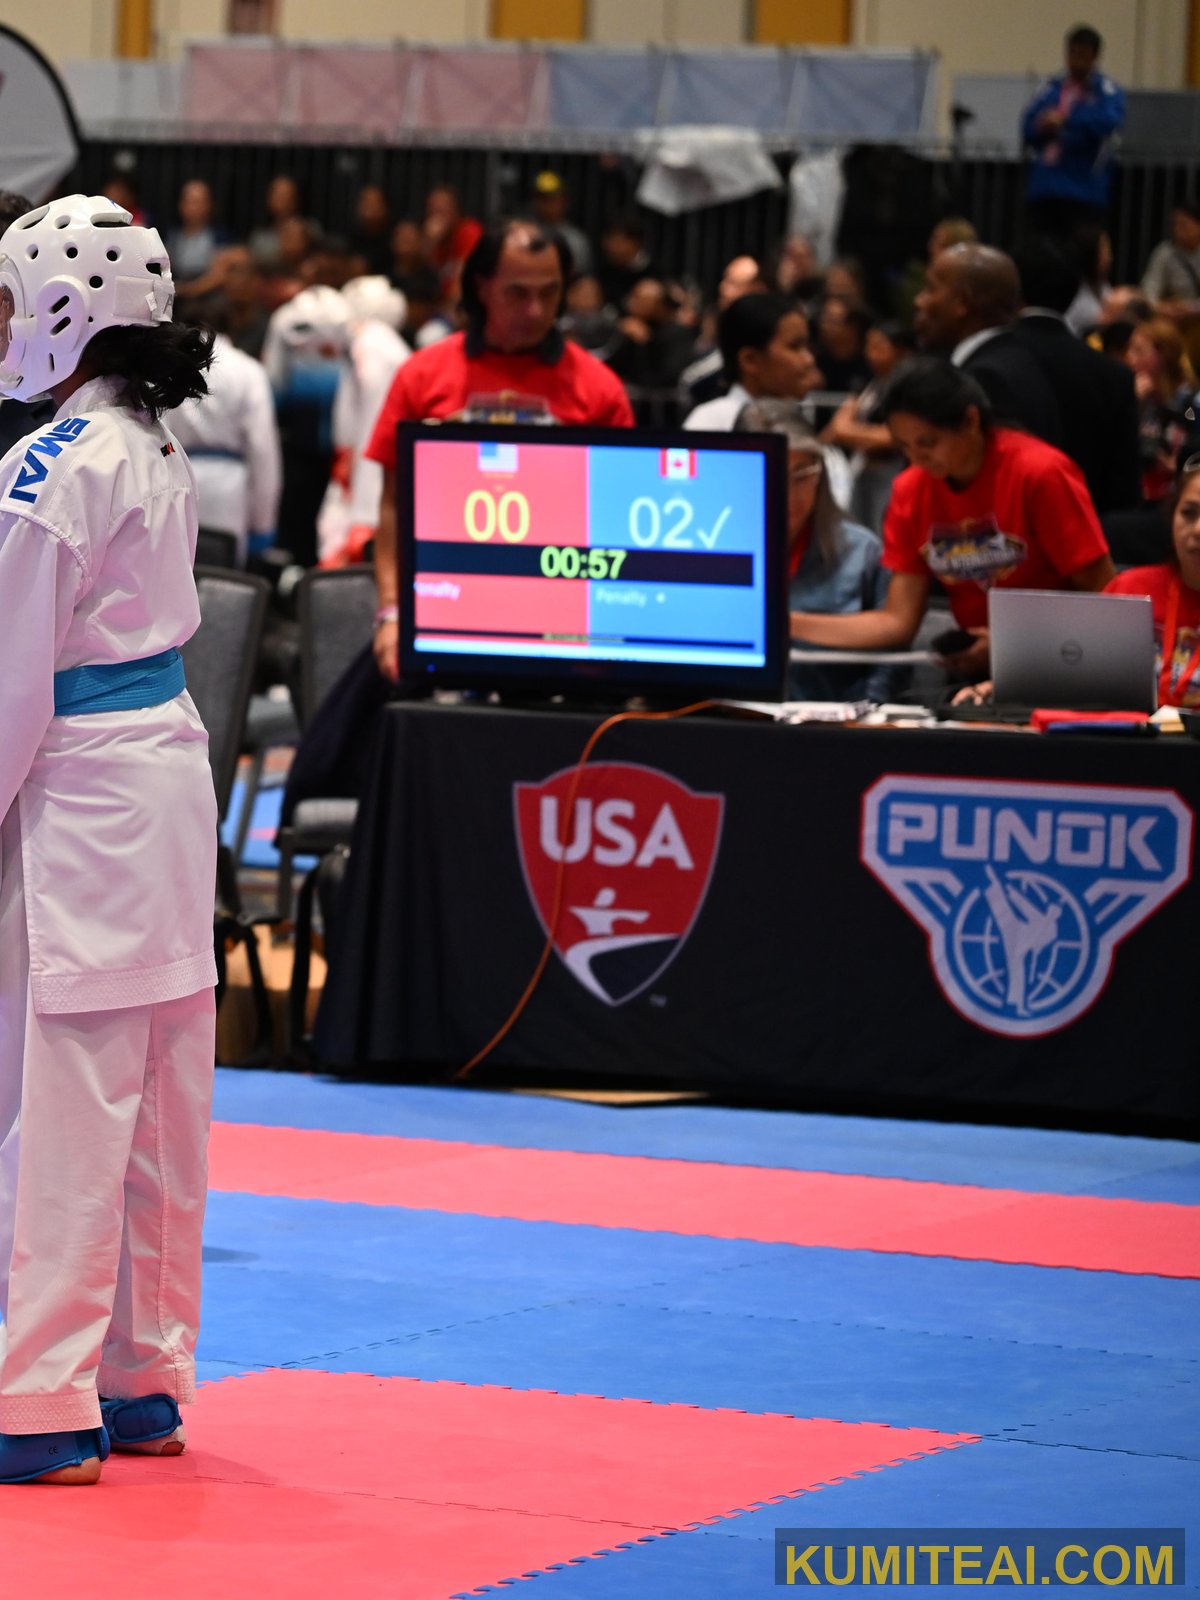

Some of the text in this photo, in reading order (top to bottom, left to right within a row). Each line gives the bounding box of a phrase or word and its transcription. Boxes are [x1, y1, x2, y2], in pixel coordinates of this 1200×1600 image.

[8, 417, 92, 504] SMAI
[464, 489, 531, 544] 00
[628, 496, 694, 549] 02
[540, 545, 628, 580] 00:57
[596, 588, 648, 608] Penalty
[539, 795, 695, 872] USA
